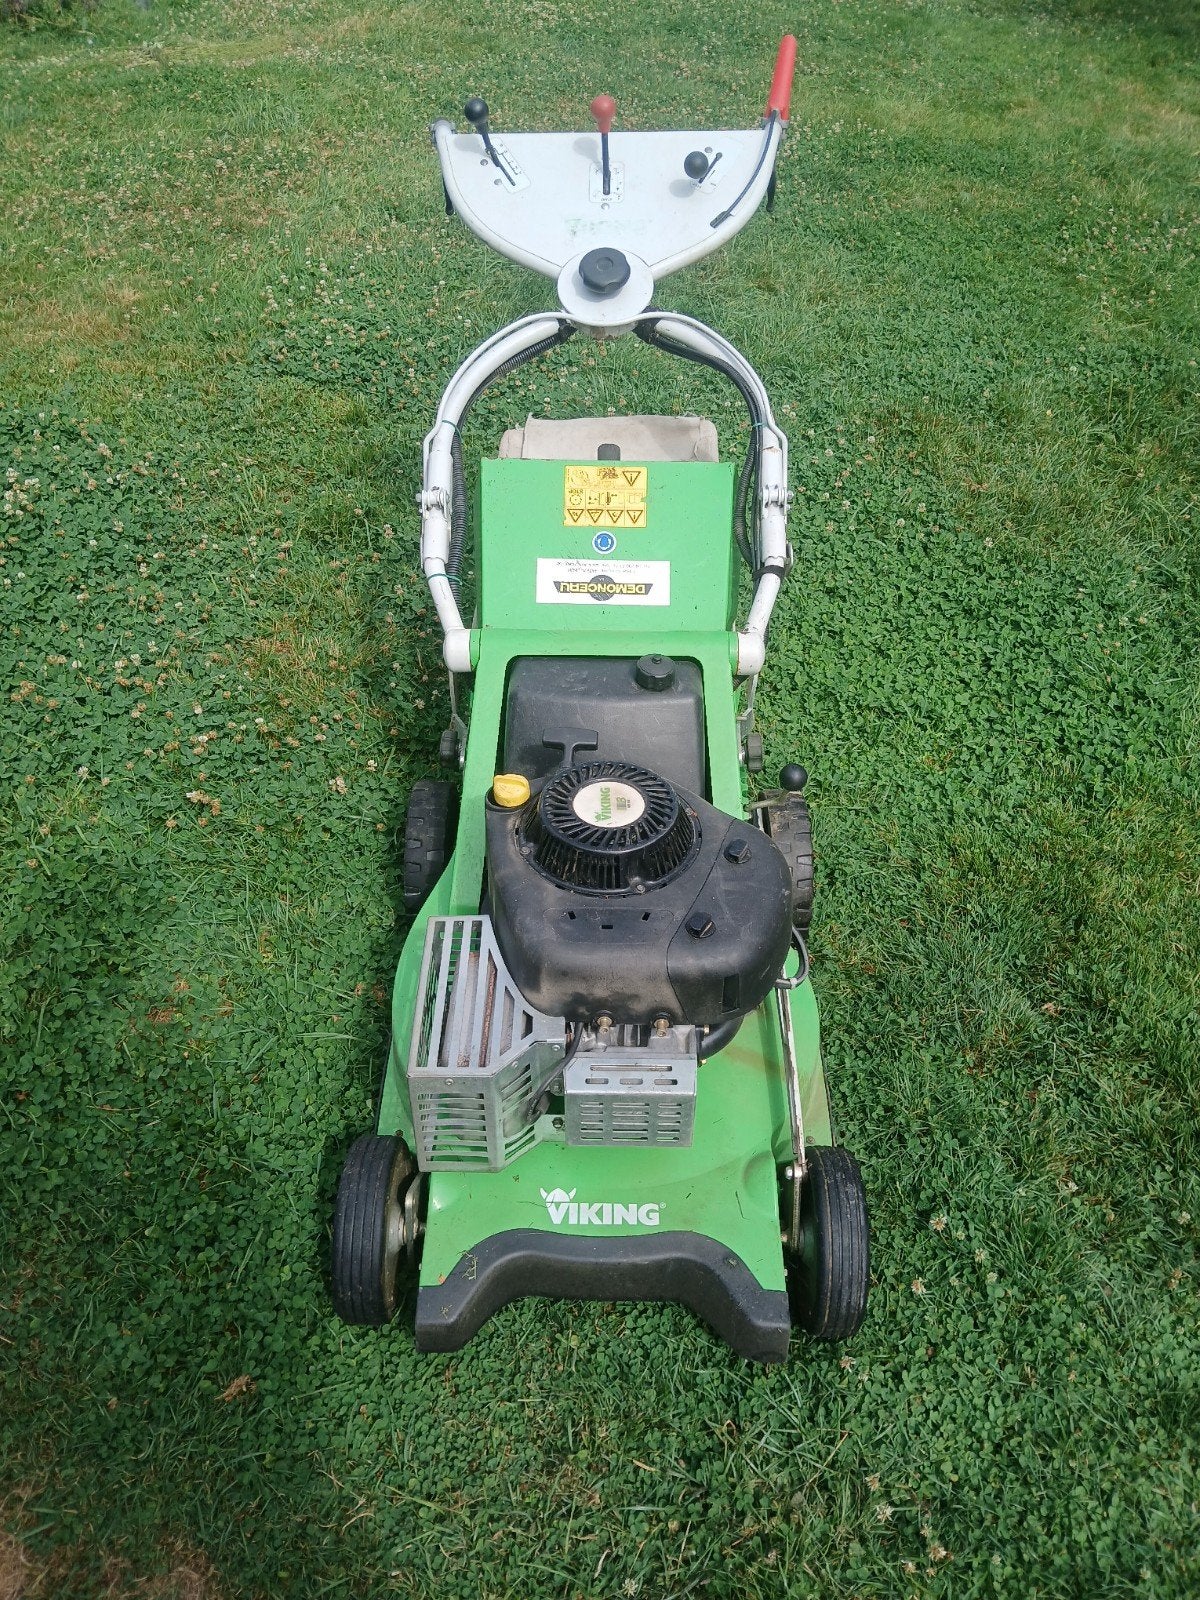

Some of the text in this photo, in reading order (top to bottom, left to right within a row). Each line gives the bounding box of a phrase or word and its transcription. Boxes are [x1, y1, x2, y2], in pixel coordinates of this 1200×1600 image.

[559, 582, 646, 595] DEMONCEAU
[600, 787, 612, 821] VIKING
[545, 1202, 660, 1226] VIKING
